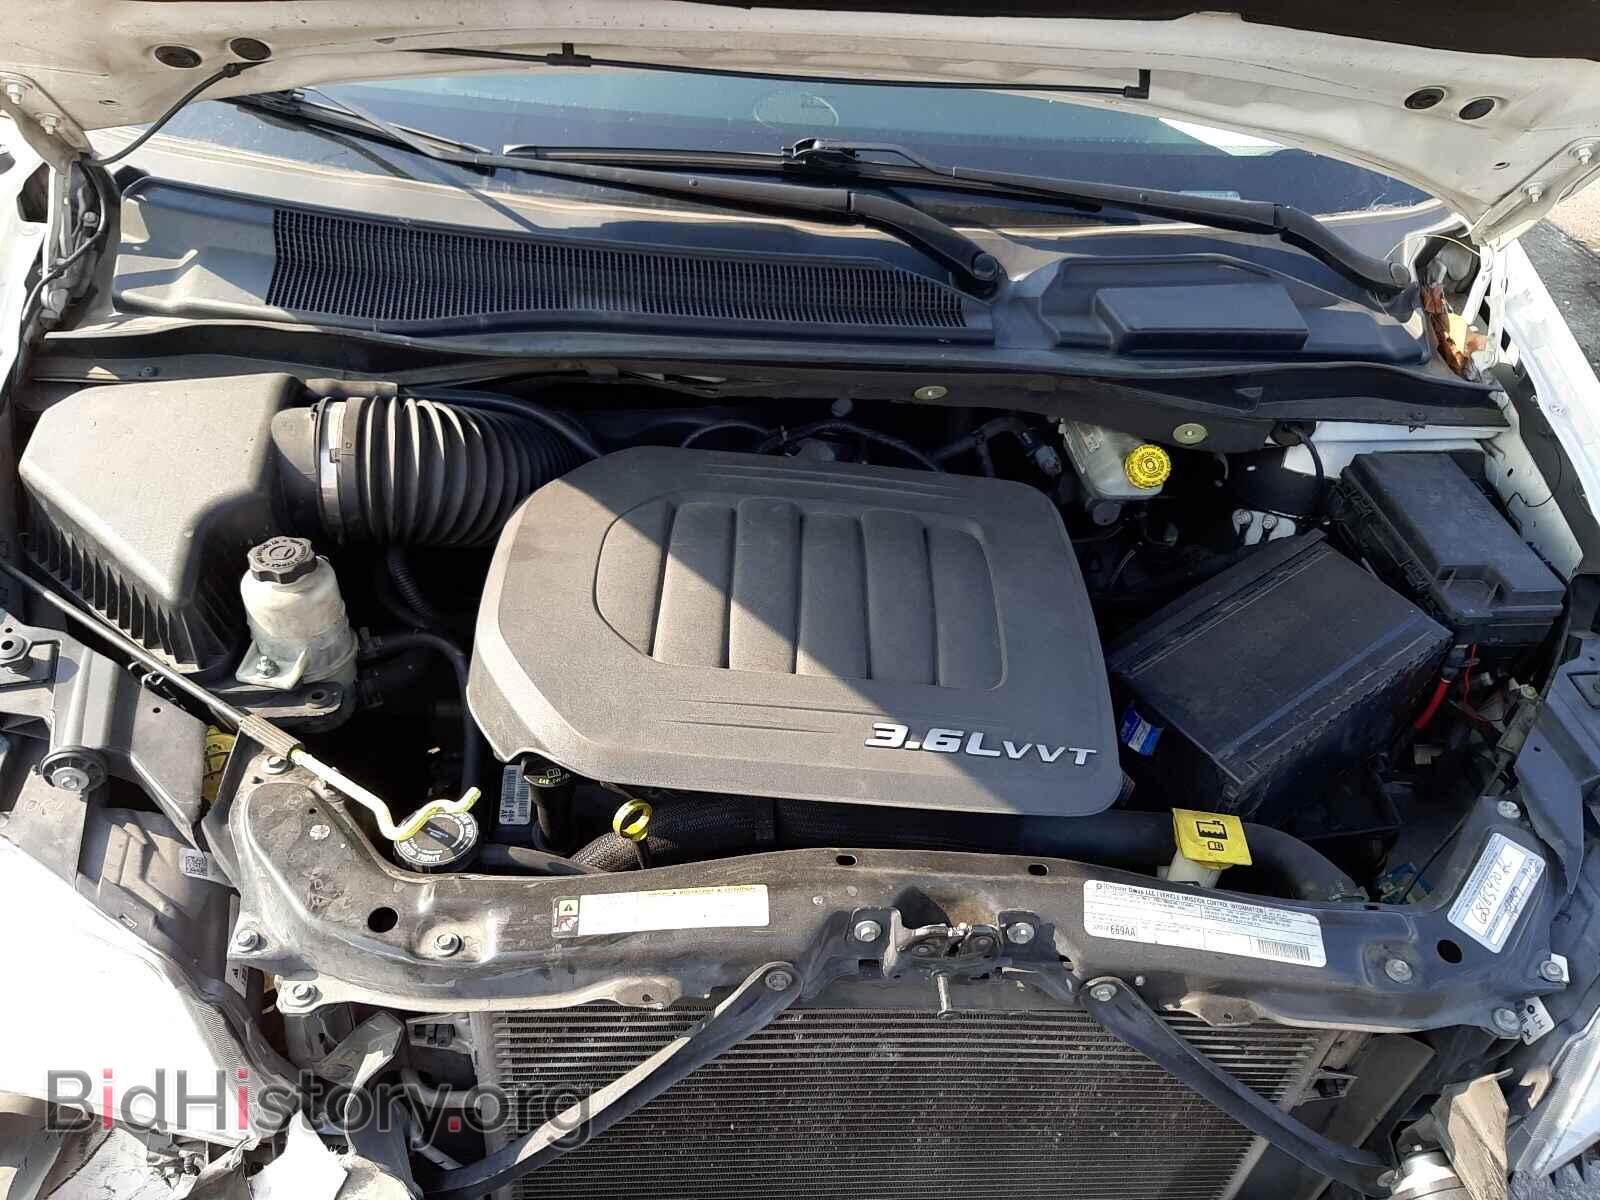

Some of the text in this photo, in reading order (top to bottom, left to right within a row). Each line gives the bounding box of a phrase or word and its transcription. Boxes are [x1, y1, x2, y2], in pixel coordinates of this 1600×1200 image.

[1181, 895, 1205, 905] EMISSION
[1206, 899, 1229, 909] CONTROL
[1230, 902, 1264, 914] INFORMATION
